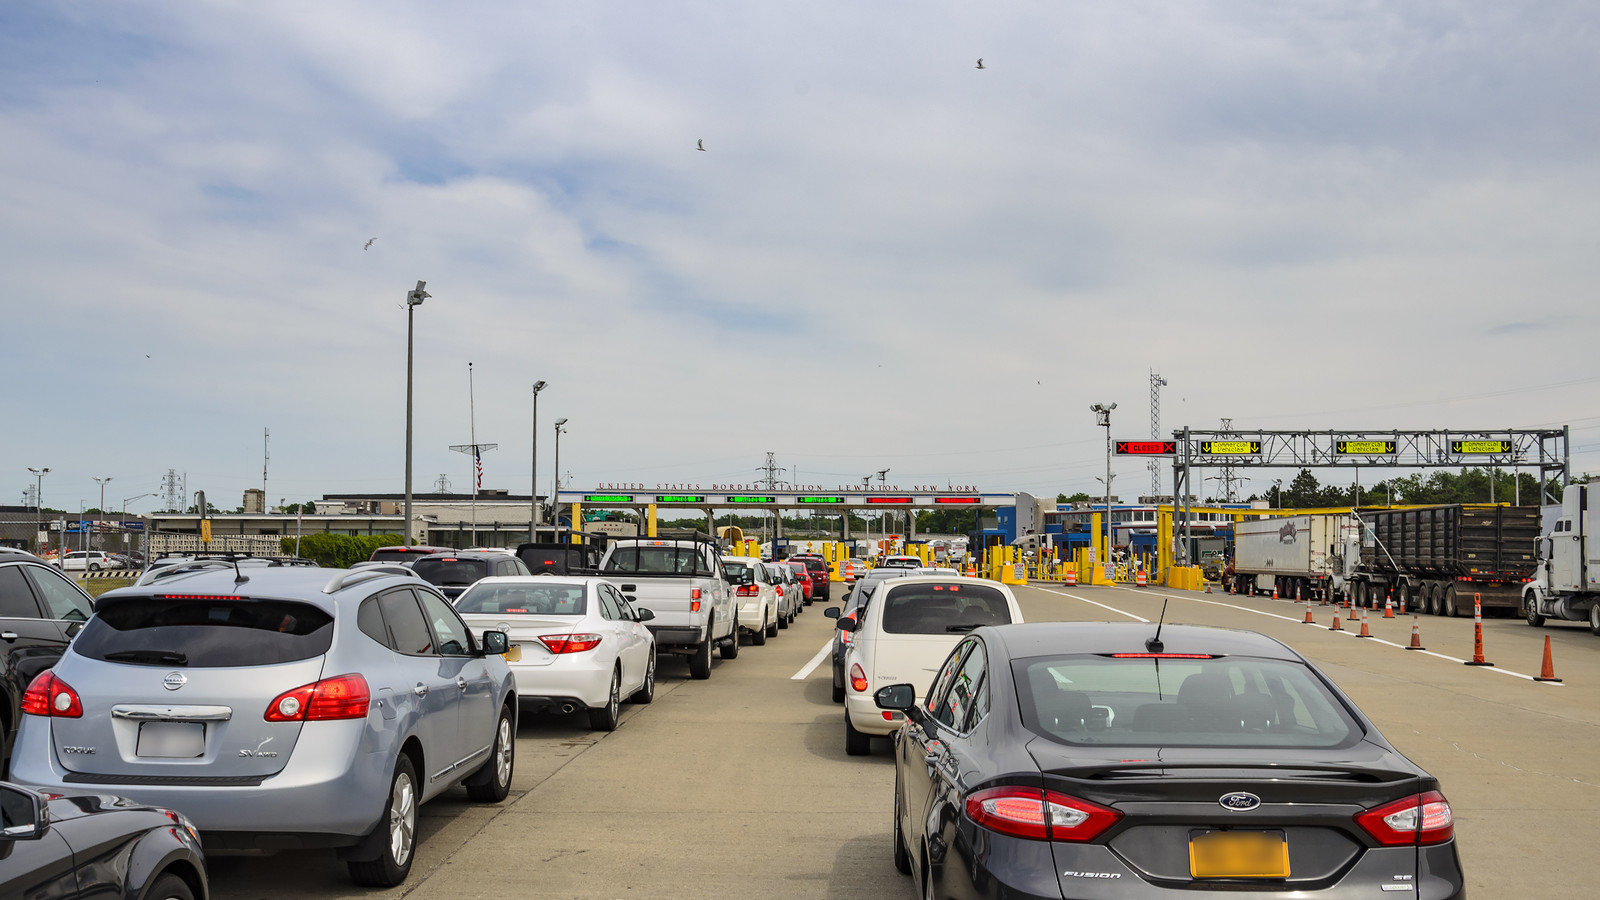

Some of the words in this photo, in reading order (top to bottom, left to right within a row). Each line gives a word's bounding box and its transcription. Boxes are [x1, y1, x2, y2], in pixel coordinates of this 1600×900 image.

[1133, 444, 1160, 452] CLOSED
[599, 482, 644, 490] UNITED
[63, 745, 97, 755] ROGUE
[238, 749, 258, 758] SV
[1228, 795, 1252, 807] Ford
[1063, 871, 1121, 879] FUSION
